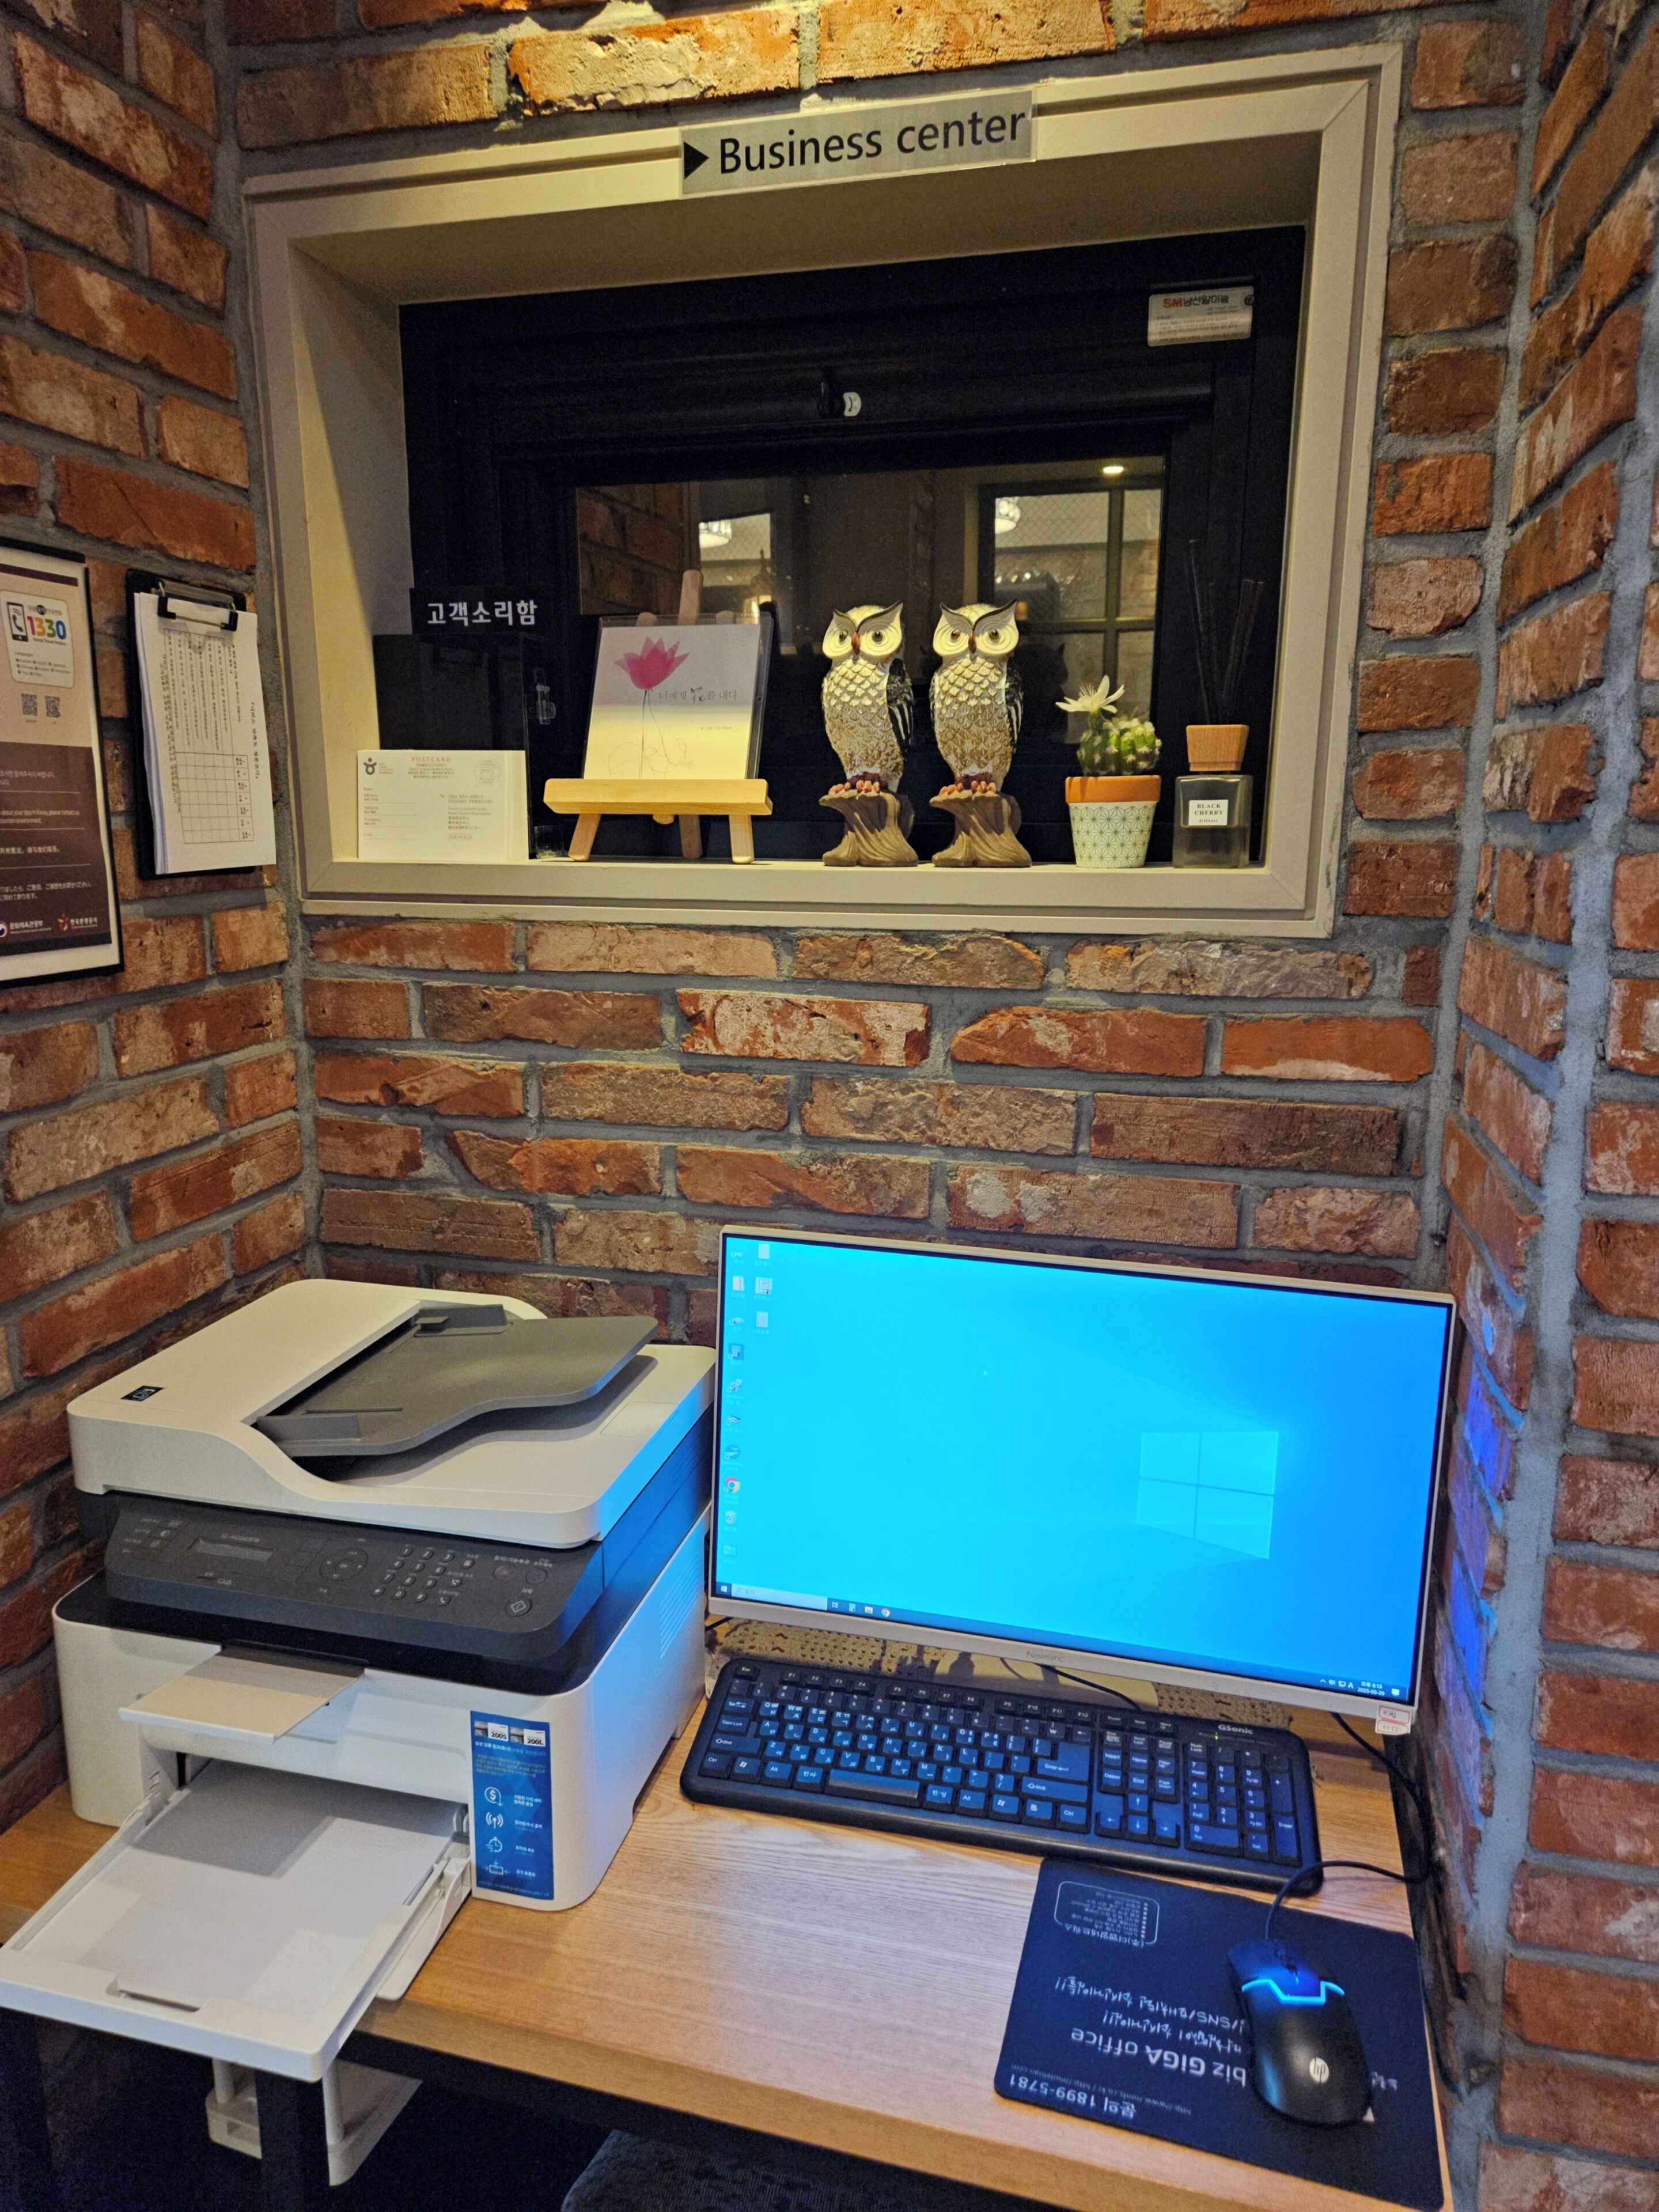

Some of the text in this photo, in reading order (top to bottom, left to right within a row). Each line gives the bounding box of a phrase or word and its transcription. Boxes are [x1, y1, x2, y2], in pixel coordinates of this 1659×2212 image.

[720, 111, 1025, 175] Business center
[26, 615, 67, 639] 1330
[427, 600, 538, 626] 고객소리함
[659, 690, 687, 701] 너에게
[719, 689, 737, 700] 내다
[1218, 1725, 1253, 1734] GSonic
[1102, 2009, 1172, 2040] 최신게임!!
[1070, 2027, 1247, 2088] biz GiGA office
[1009, 2073, 1137, 2120] 문의 1899-5781
